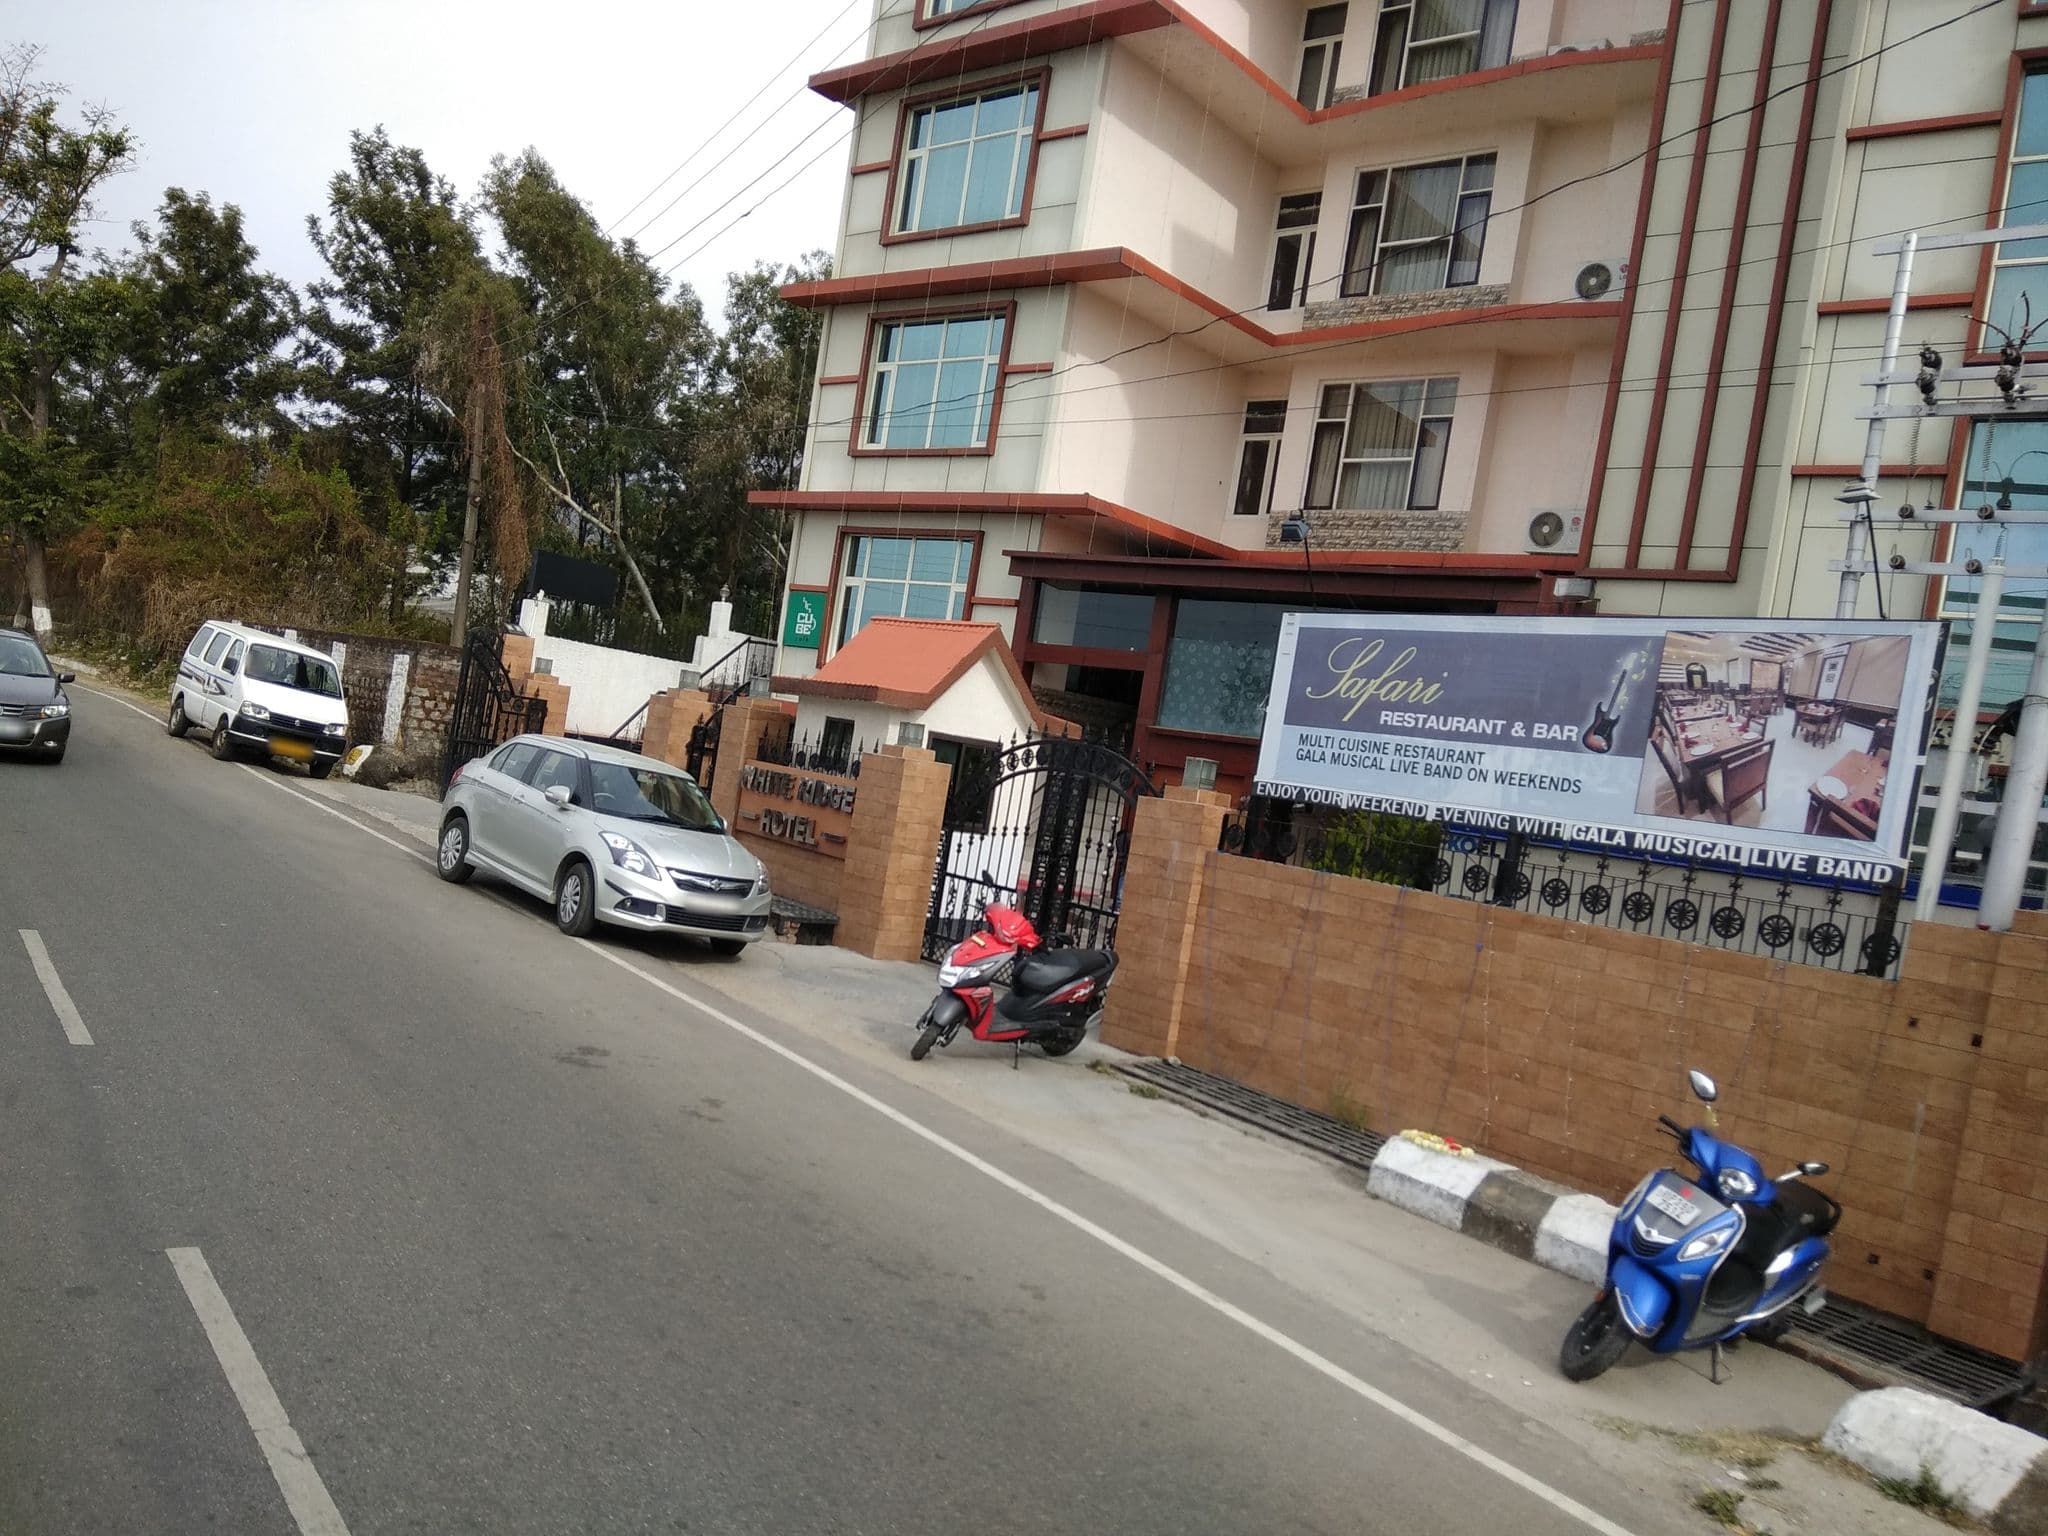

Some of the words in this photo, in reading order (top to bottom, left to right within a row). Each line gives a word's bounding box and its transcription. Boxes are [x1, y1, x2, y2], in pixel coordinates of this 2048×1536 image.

[1305, 637, 1449, 721] Safari
[1380, 711, 1506, 737] RESTAURANT
[1511, 721, 1526, 738] &
[1532, 723, 1579, 742] BAR
[1298, 734, 1335, 749] MULTI
[1338, 738, 1389, 756] CUISINE
[1394, 743, 1486, 766] RESTAURANT
[741, 764, 797, 801] WHITE
[1295, 748, 1327, 763] GALA
[1330, 752, 1387, 771] MUSICAL
[1390, 758, 1419, 775] LIVE
[1423, 763, 1463, 780] BAND
[1467, 768, 1488, 783] ON
[1494, 770, 1583, 794] WEEKENDS
[760, 807, 818, 846] HOTEL
[1256, 782, 1299, 800] ENJOY
[1303, 786, 1343, 806] YOUR
[1347, 793, 1428, 819] WEEKEND
[1432, 807, 1509, 831] EVENING
[1517, 816, 1565, 837] WITH
[1571, 824, 1626, 847] GALA
[1634, 832, 1740, 862] MUSICAL
[1751, 850, 1808, 872] LIVE
[1816, 858, 1893, 885] BAND
